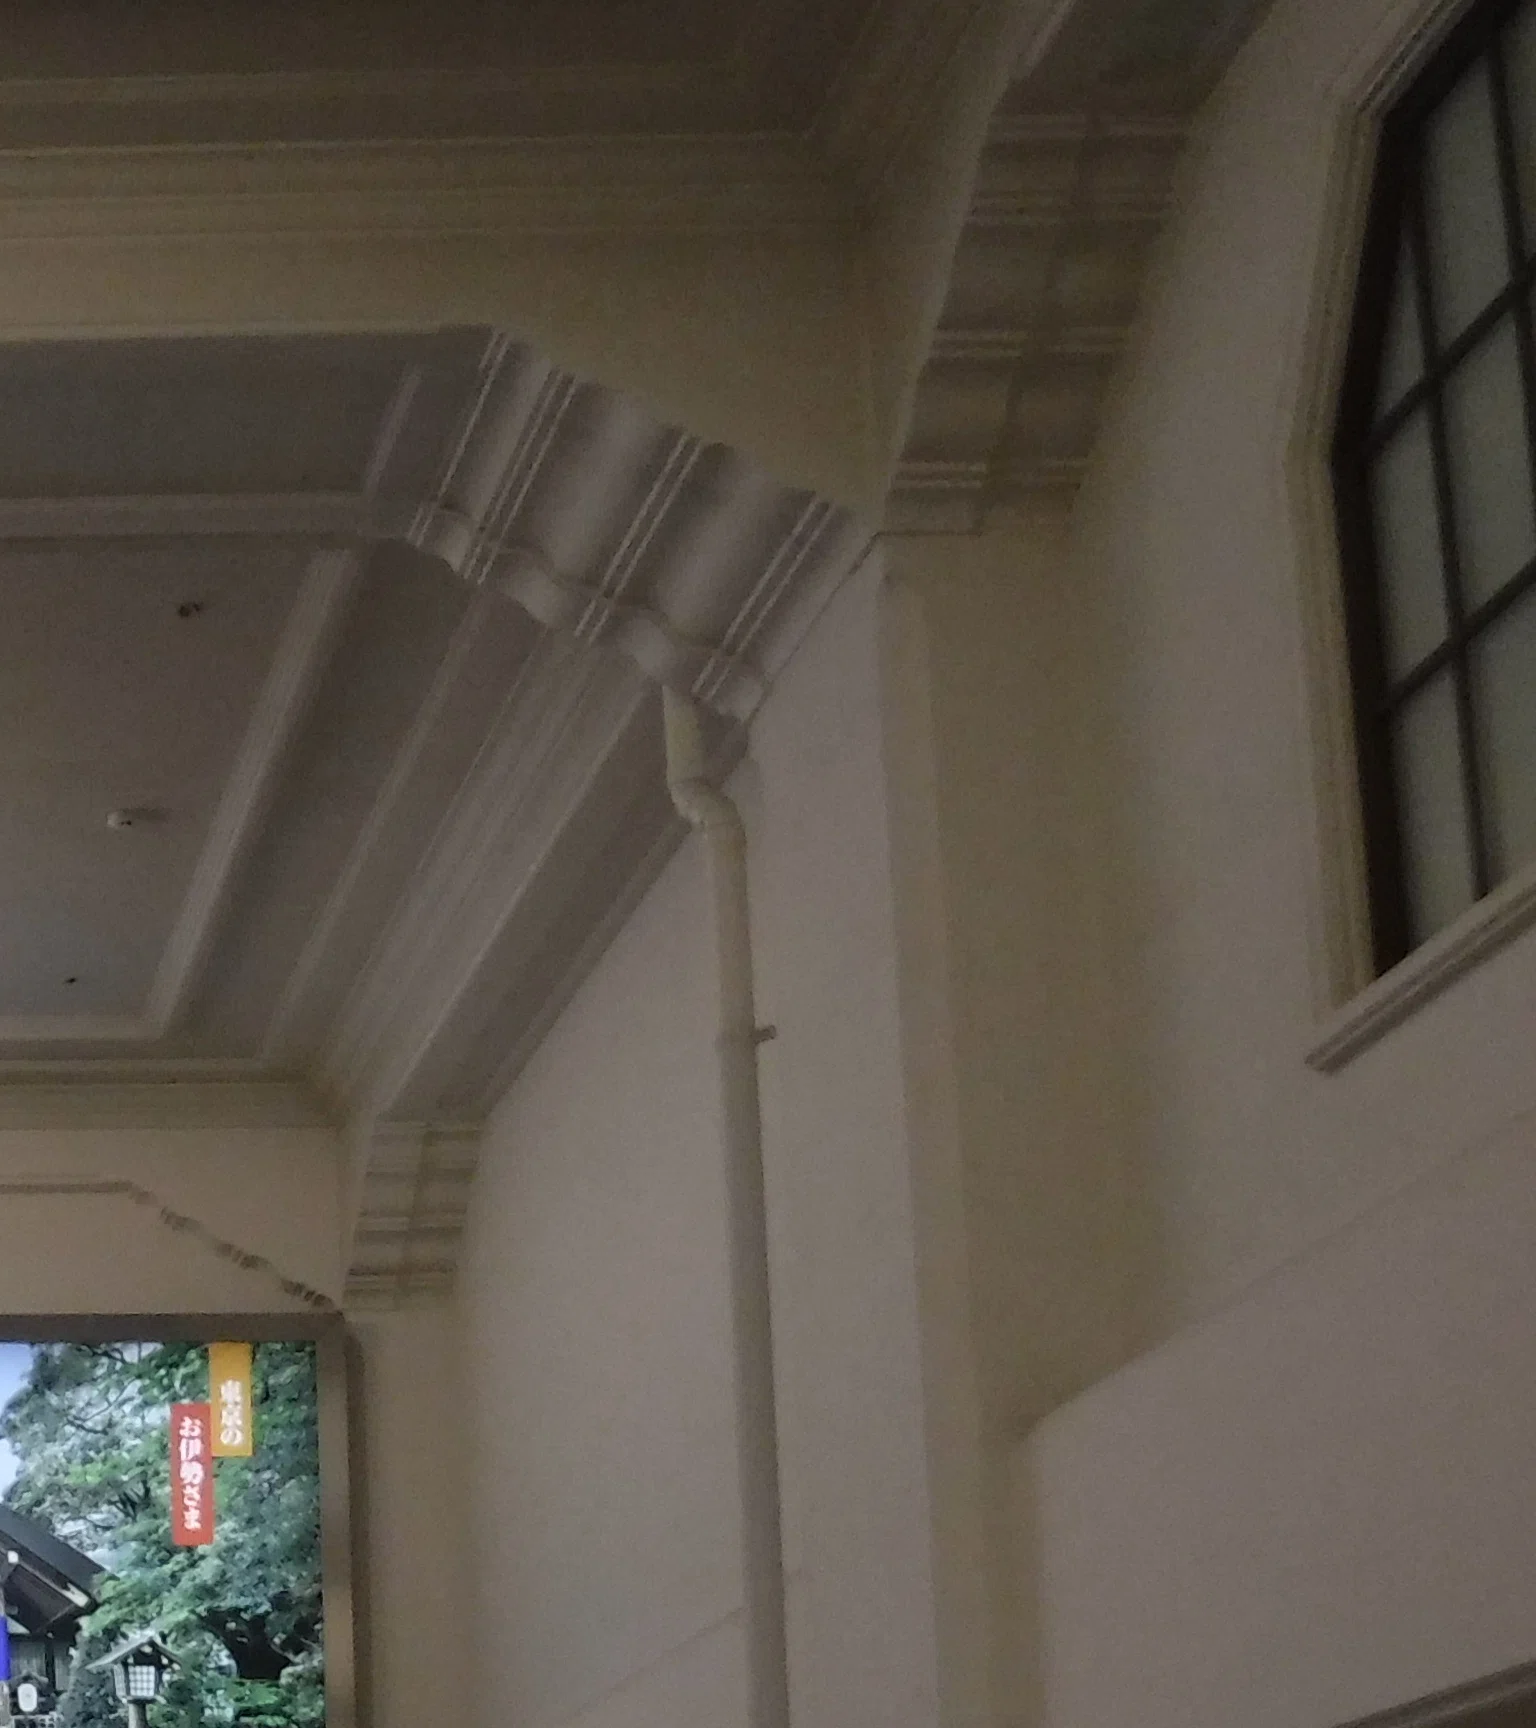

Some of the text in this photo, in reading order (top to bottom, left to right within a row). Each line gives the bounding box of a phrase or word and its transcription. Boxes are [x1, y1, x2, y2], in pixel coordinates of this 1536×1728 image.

[218, 1379, 242, 1446] 東京の
[177, 1415, 207, 1531] お伊勢さま
